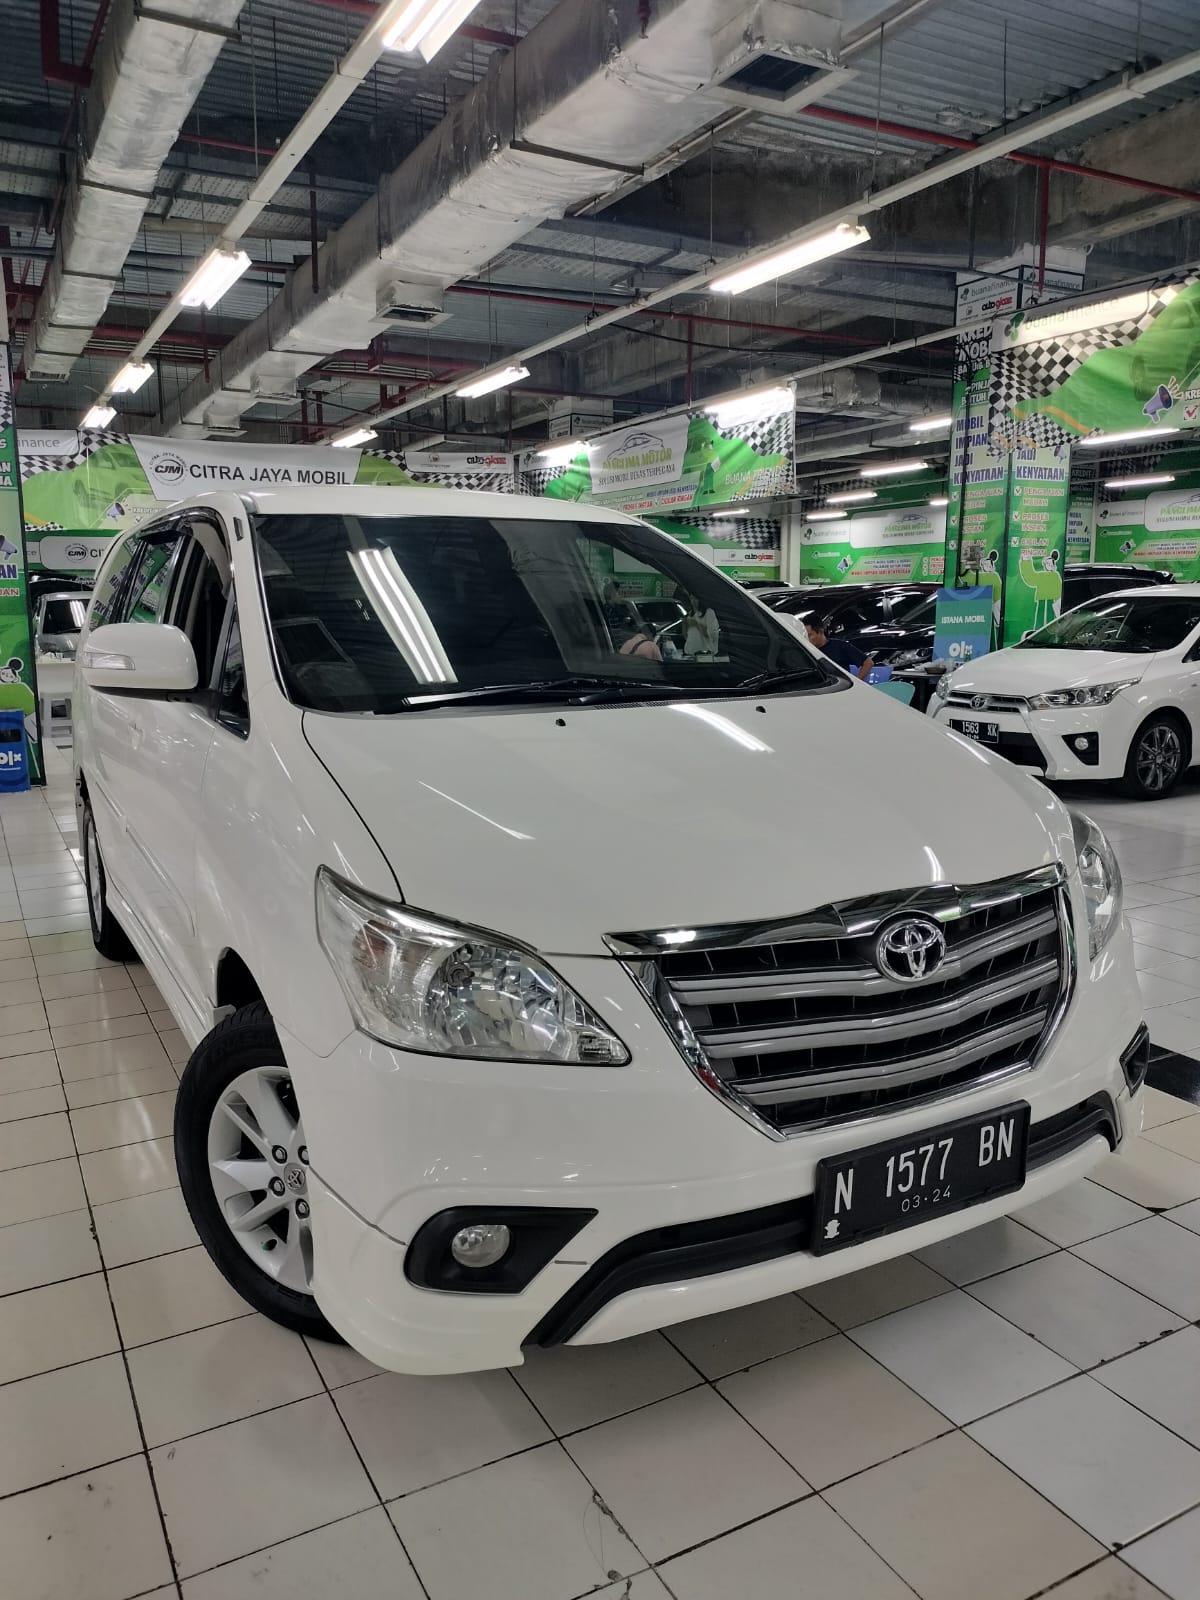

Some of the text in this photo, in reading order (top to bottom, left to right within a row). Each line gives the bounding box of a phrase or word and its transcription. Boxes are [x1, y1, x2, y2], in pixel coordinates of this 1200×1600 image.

[154, 464, 182, 474] CJM
[189, 464, 351, 485] CITRA JAYA MOBIL
[1016, 465, 1065, 481] KENYATAAN
[962, 721, 980, 735] 1563
[834, 1119, 1015, 1214] N 1577 BN
